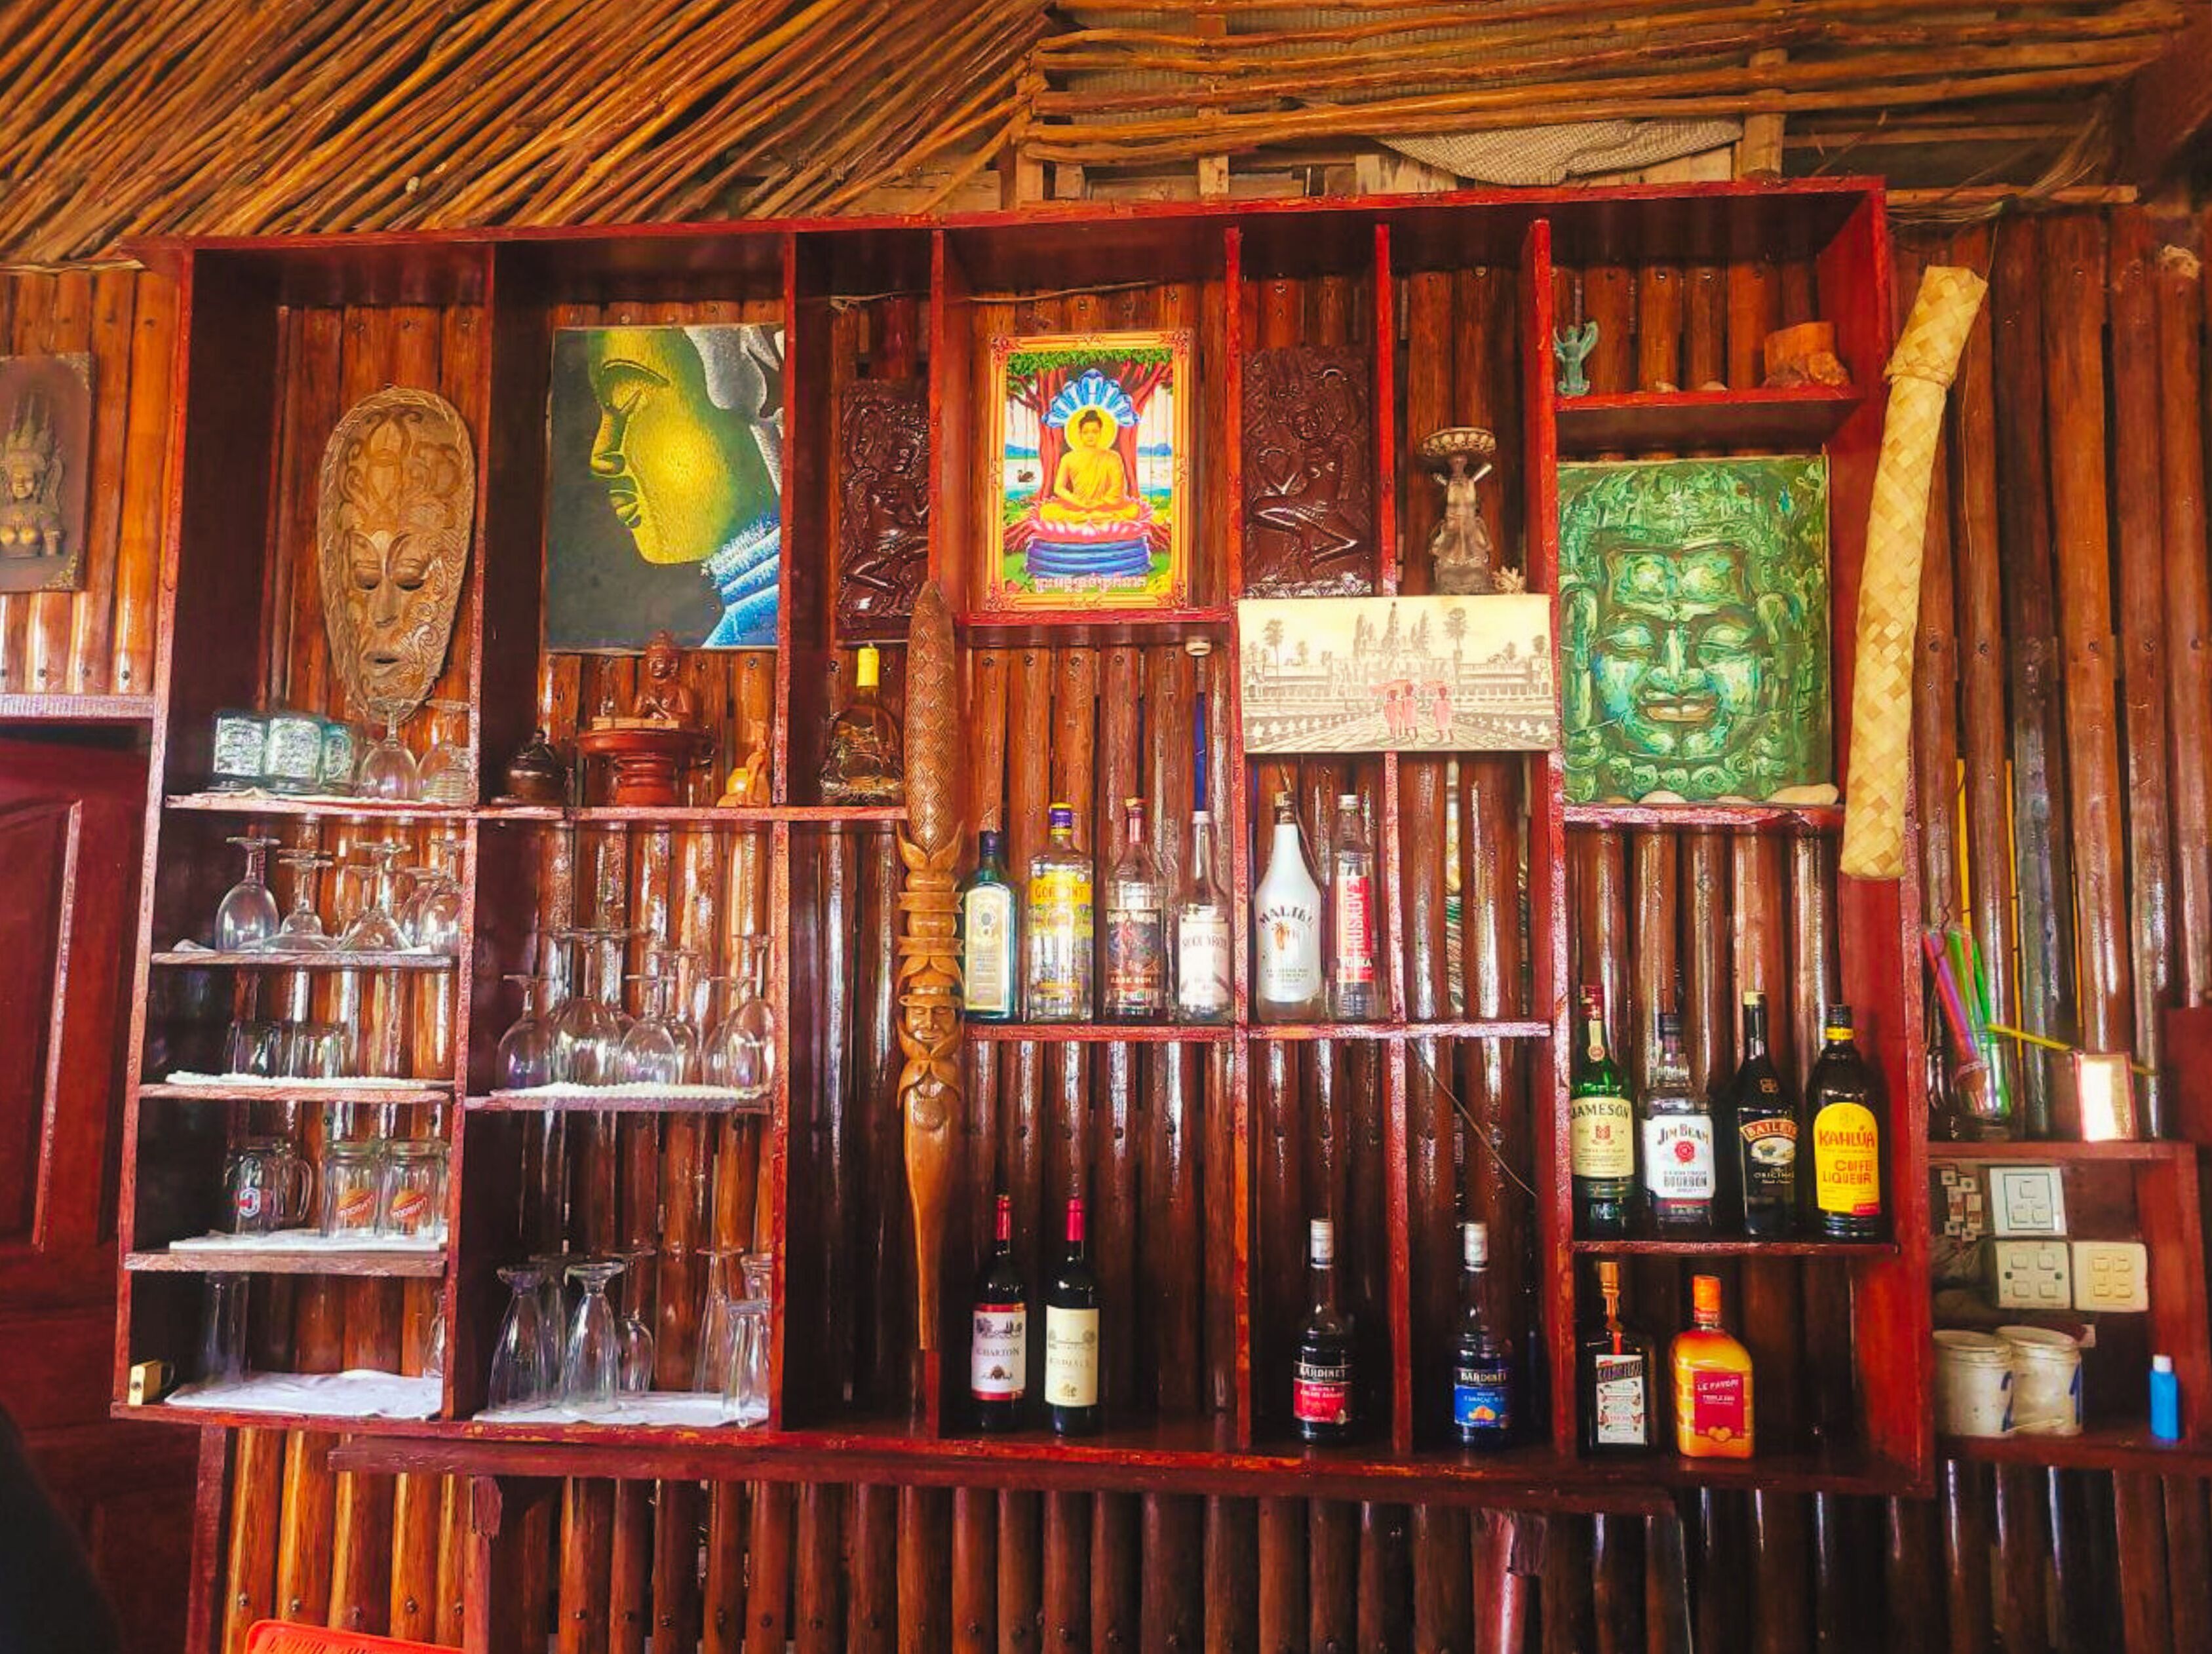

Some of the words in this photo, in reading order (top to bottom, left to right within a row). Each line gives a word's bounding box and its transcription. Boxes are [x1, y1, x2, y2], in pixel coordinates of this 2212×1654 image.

[1035, 884, 1086, 898] GORON'S
[1259, 906, 1315, 929] MALIBU
[1572, 1104, 1629, 1119] JAMESON
[1658, 1128, 1677, 1145] JIM
[1679, 1123, 1709, 1145] BEAM
[1823, 1171, 1872, 1185] LIQUEUR
